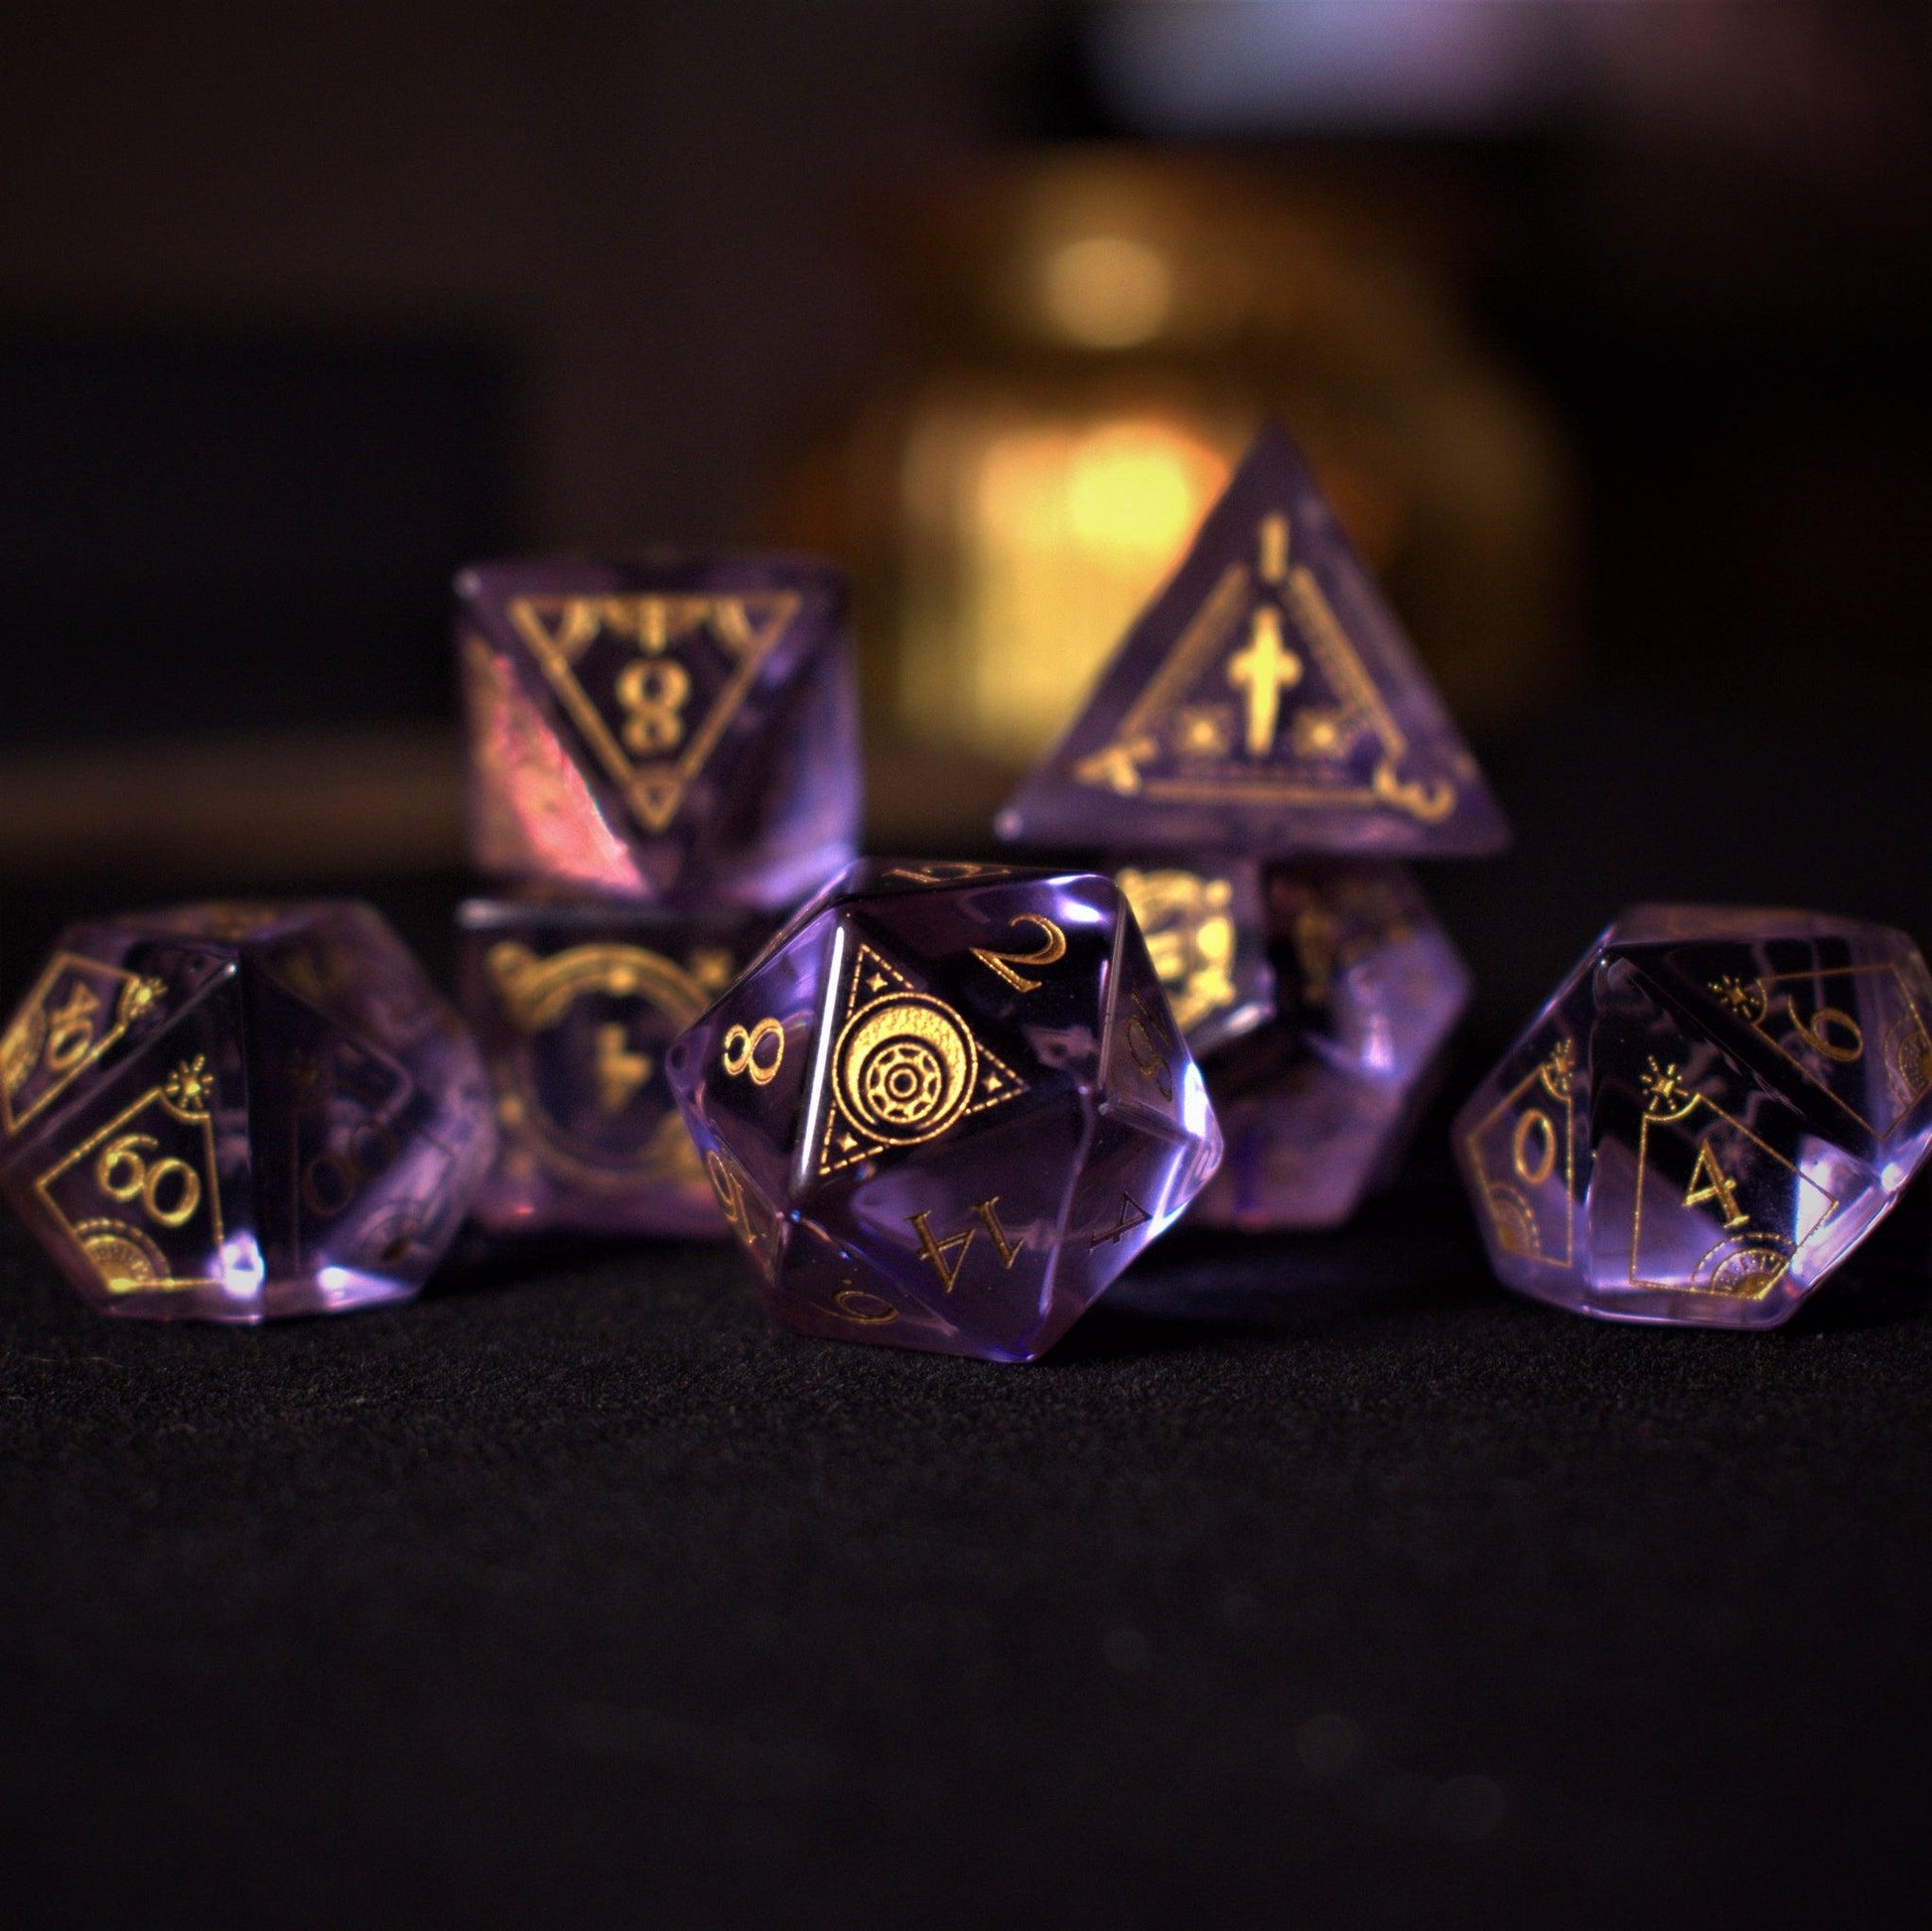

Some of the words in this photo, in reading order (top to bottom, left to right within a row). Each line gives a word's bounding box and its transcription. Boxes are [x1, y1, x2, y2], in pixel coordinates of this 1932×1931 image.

[616, 657, 690, 755] 8
[969, 913, 1066, 992] 2
[723, 1018, 784, 1085] 8
[1787, 993, 1863, 1062] 6
[96, 1134, 200, 1227] 60
[1514, 1109, 1556, 1184] 0
[1681, 1138, 1749, 1228] 4
[905, 1196, 1024, 1292] 14
